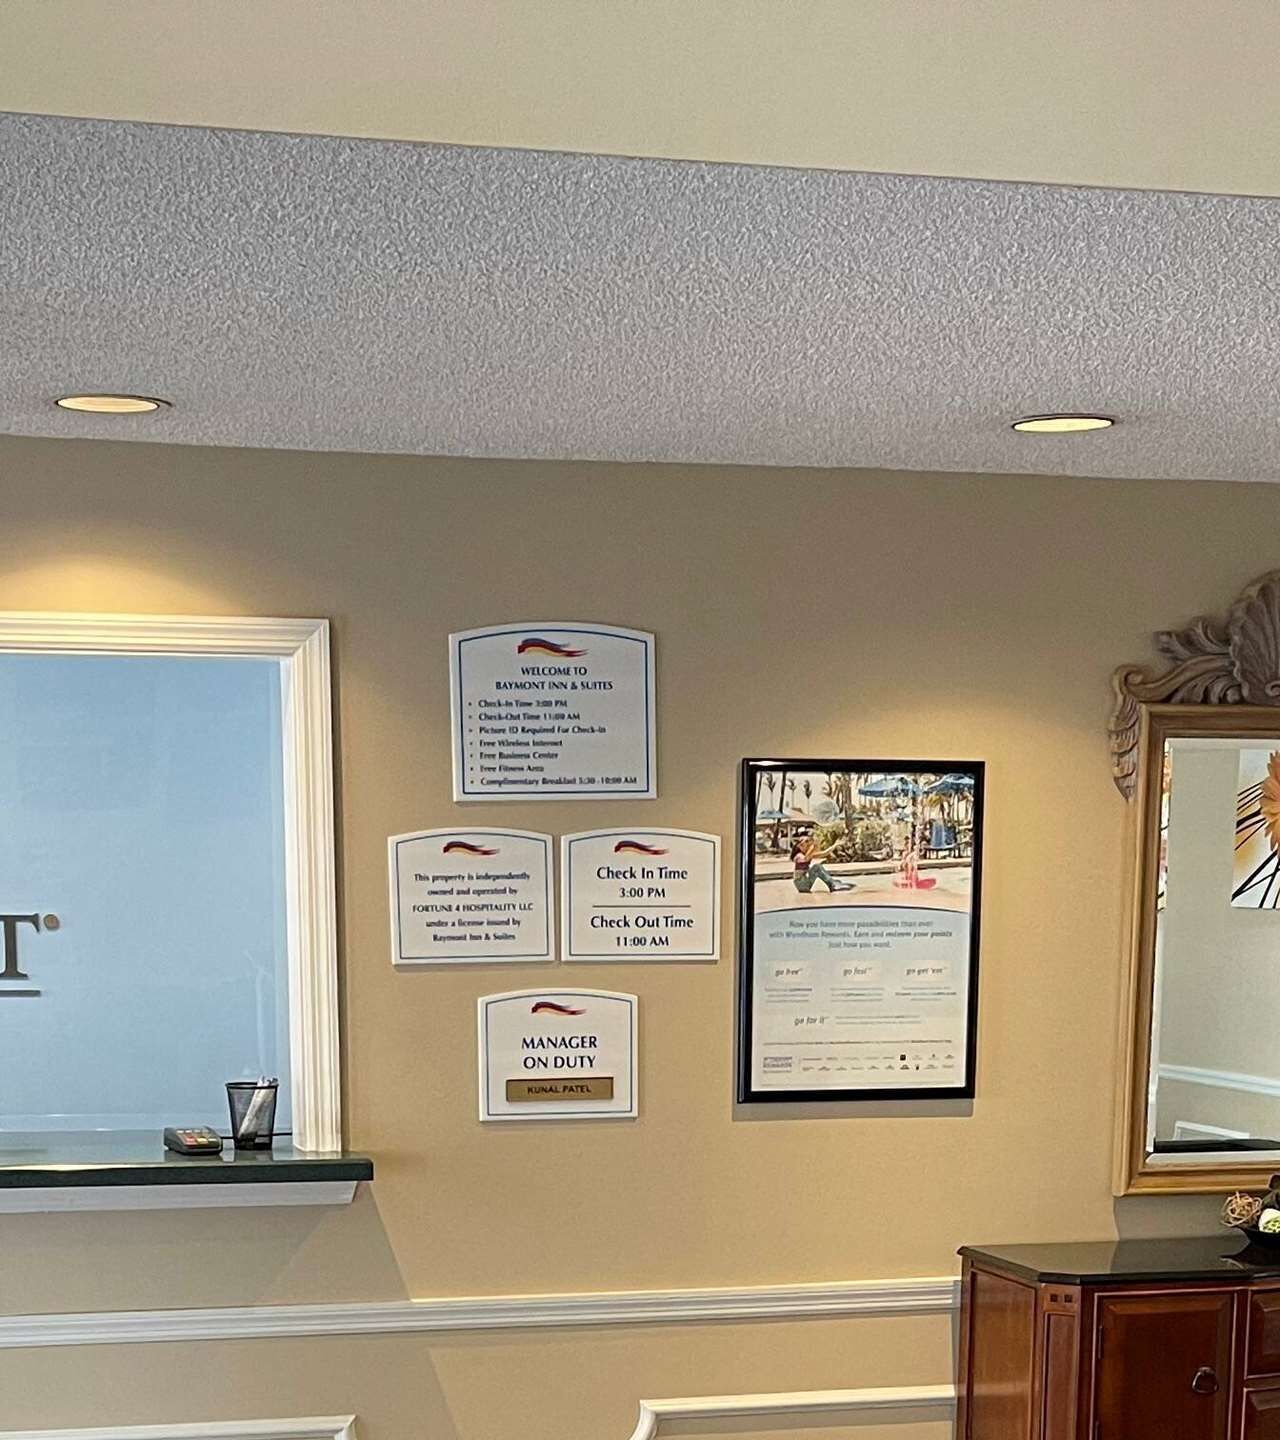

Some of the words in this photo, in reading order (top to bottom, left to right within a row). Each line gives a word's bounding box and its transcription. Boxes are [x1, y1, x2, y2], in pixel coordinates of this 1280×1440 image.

[520, 666, 571, 676] WELCOME
[573, 666, 588, 676] TO
[495, 681, 545, 690] BAYMONT
[548, 681, 568, 690] INN
[570, 681, 578, 690] &
[581, 681, 614, 690] SUITES
[515, 700, 533, 708] Time
[554, 700, 568, 708] PM
[522, 713, 541, 721] Time
[479, 726, 506, 735] Picture
[508, 726, 519, 734] ID
[521, 726, 555, 735] Required
[480, 752, 496, 760] Free
[480, 777, 539, 787] Complimentary
[414, 873, 430, 881] This
[431, 874, 465, 883] property
[475, 872, 530, 882] independently
[596, 866, 637, 880] Check
[641, 866, 654, 879] In
[657, 866, 688, 880] Time
[427, 887, 454, 896] owned
[456, 887, 471, 895] and
[472, 887, 507, 897] operated
[508, 886, 518, 895] by
[619, 887, 644, 898] 3:00
[647, 887, 666, 898] PM
[412, 904, 453, 913] FORTUNE
[462, 903, 517, 912] HOSPITALITY
[519, 903, 534, 911] LLC
[425, 920, 449, 928] under
[512, 917, 521, 927] by
[590, 915, 631, 928] Check
[634, 915, 660, 928] Out
[663, 915, 694, 928] Time
[616, 936, 647, 947] 11:00
[649, 936, 669, 946] AM
[521, 1036, 598, 1049] MANAGER
[523, 1056, 548, 1069] ON
[553, 1055, 596, 1069] DUTY
[527, 1085, 560, 1094] KUNAL
[562, 1084, 592, 1093] PATEL
